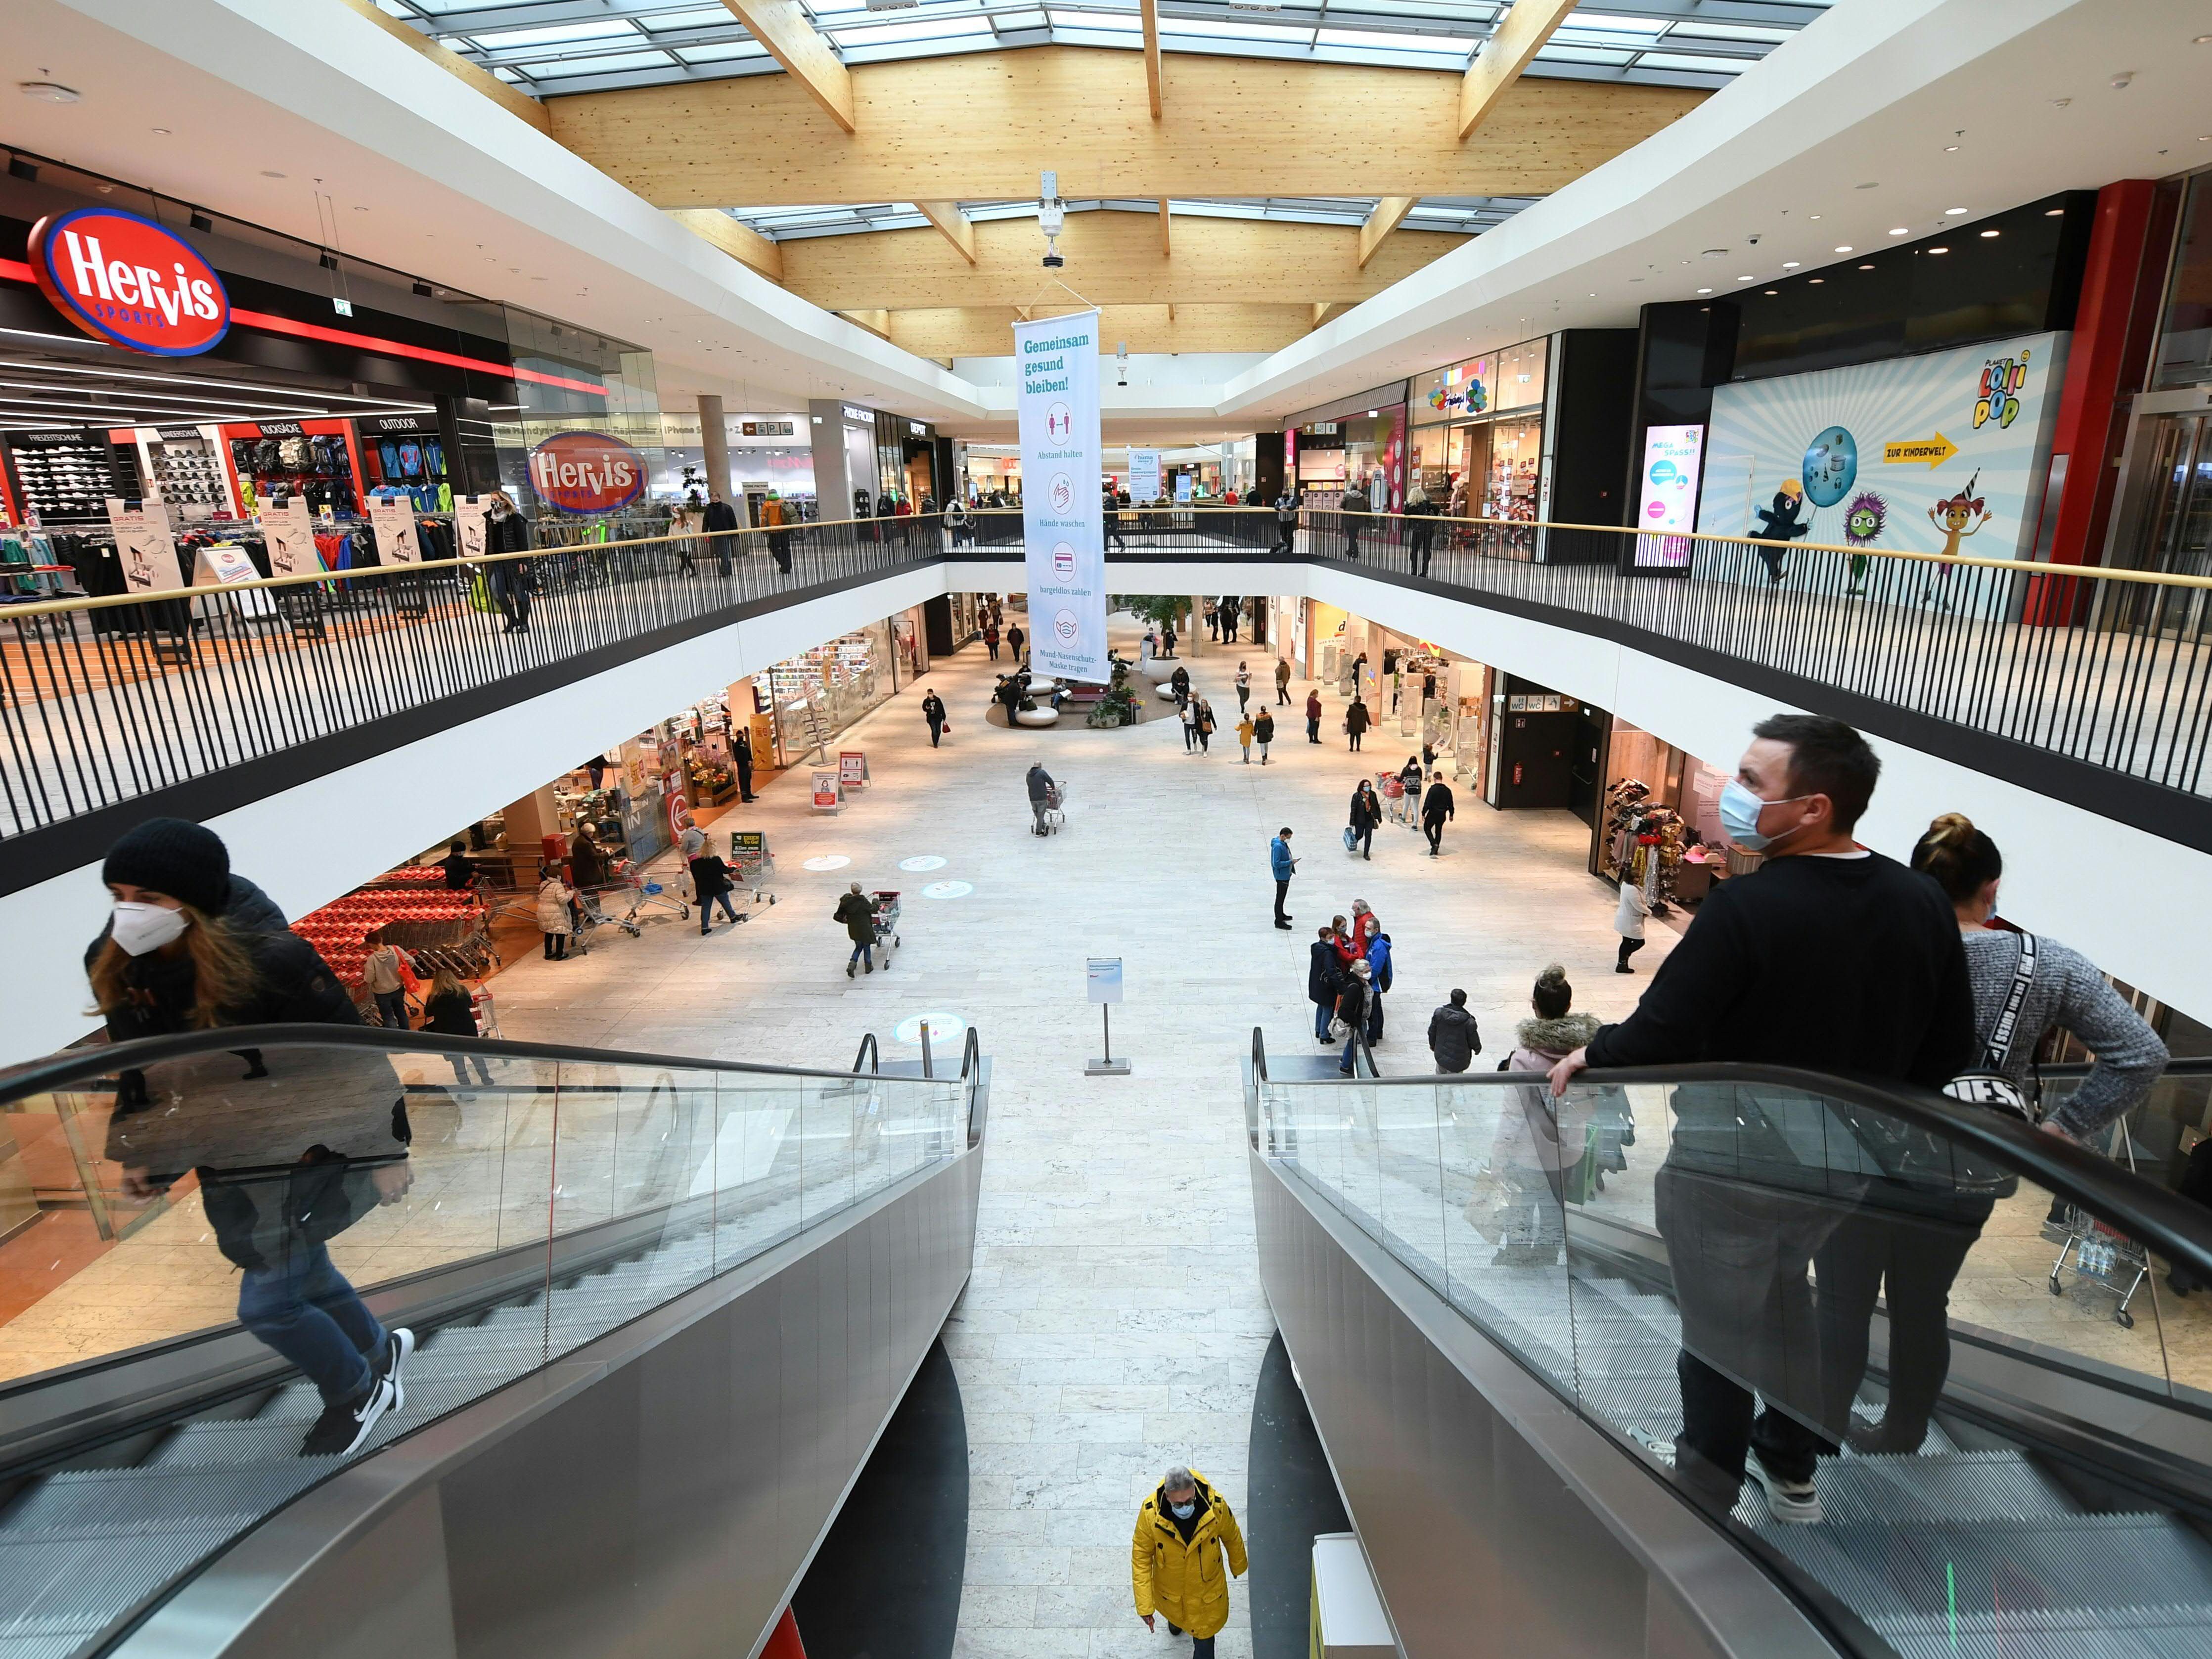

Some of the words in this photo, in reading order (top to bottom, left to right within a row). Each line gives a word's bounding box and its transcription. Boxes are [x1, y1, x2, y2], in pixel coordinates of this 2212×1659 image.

[63, 229, 219, 326] Hervis
[95, 303, 166, 329] SPORTS
[1024, 334, 1089, 354] Gemeinsam
[1025, 356, 1064, 376] gesund
[1985, 358, 2008, 367] PLANET
[1026, 376, 1068, 395] bleiben!
[858, 410, 874, 424] FACTORY
[261, 423, 303, 435] RUCKSÄCKE
[379, 418, 419, 430] OUTDOOR
[910, 422, 926, 435] DEPOT
[28, 434, 83, 442] FREIZEITSCHUHE
[160, 429, 200, 438] WANDERSCHUHE
[1038, 451, 1062, 459] Abstand
[1064, 449, 1083, 458] halten
[1887, 448, 1901, 458] ZUR
[1903, 446, 1946, 457] KINDERWELT
[537, 452, 632, 495] Hervis
[549, 490, 594, 499] SPORTS
[1039, 519, 1059, 527] Hände
[1060, 519, 1085, 528] waschen
[1039, 585, 1070, 595] bargeldlos
[1071, 588, 1091, 596] zahlen
[1039, 649, 1096, 663] Mund-Nasenschutz-
[1049, 660, 1068, 670] Maske
[1068, 664, 1088, 673] tragen
[627, 811, 641, 831] IN
[1994, 1010, 2016, 1043] GUESS
